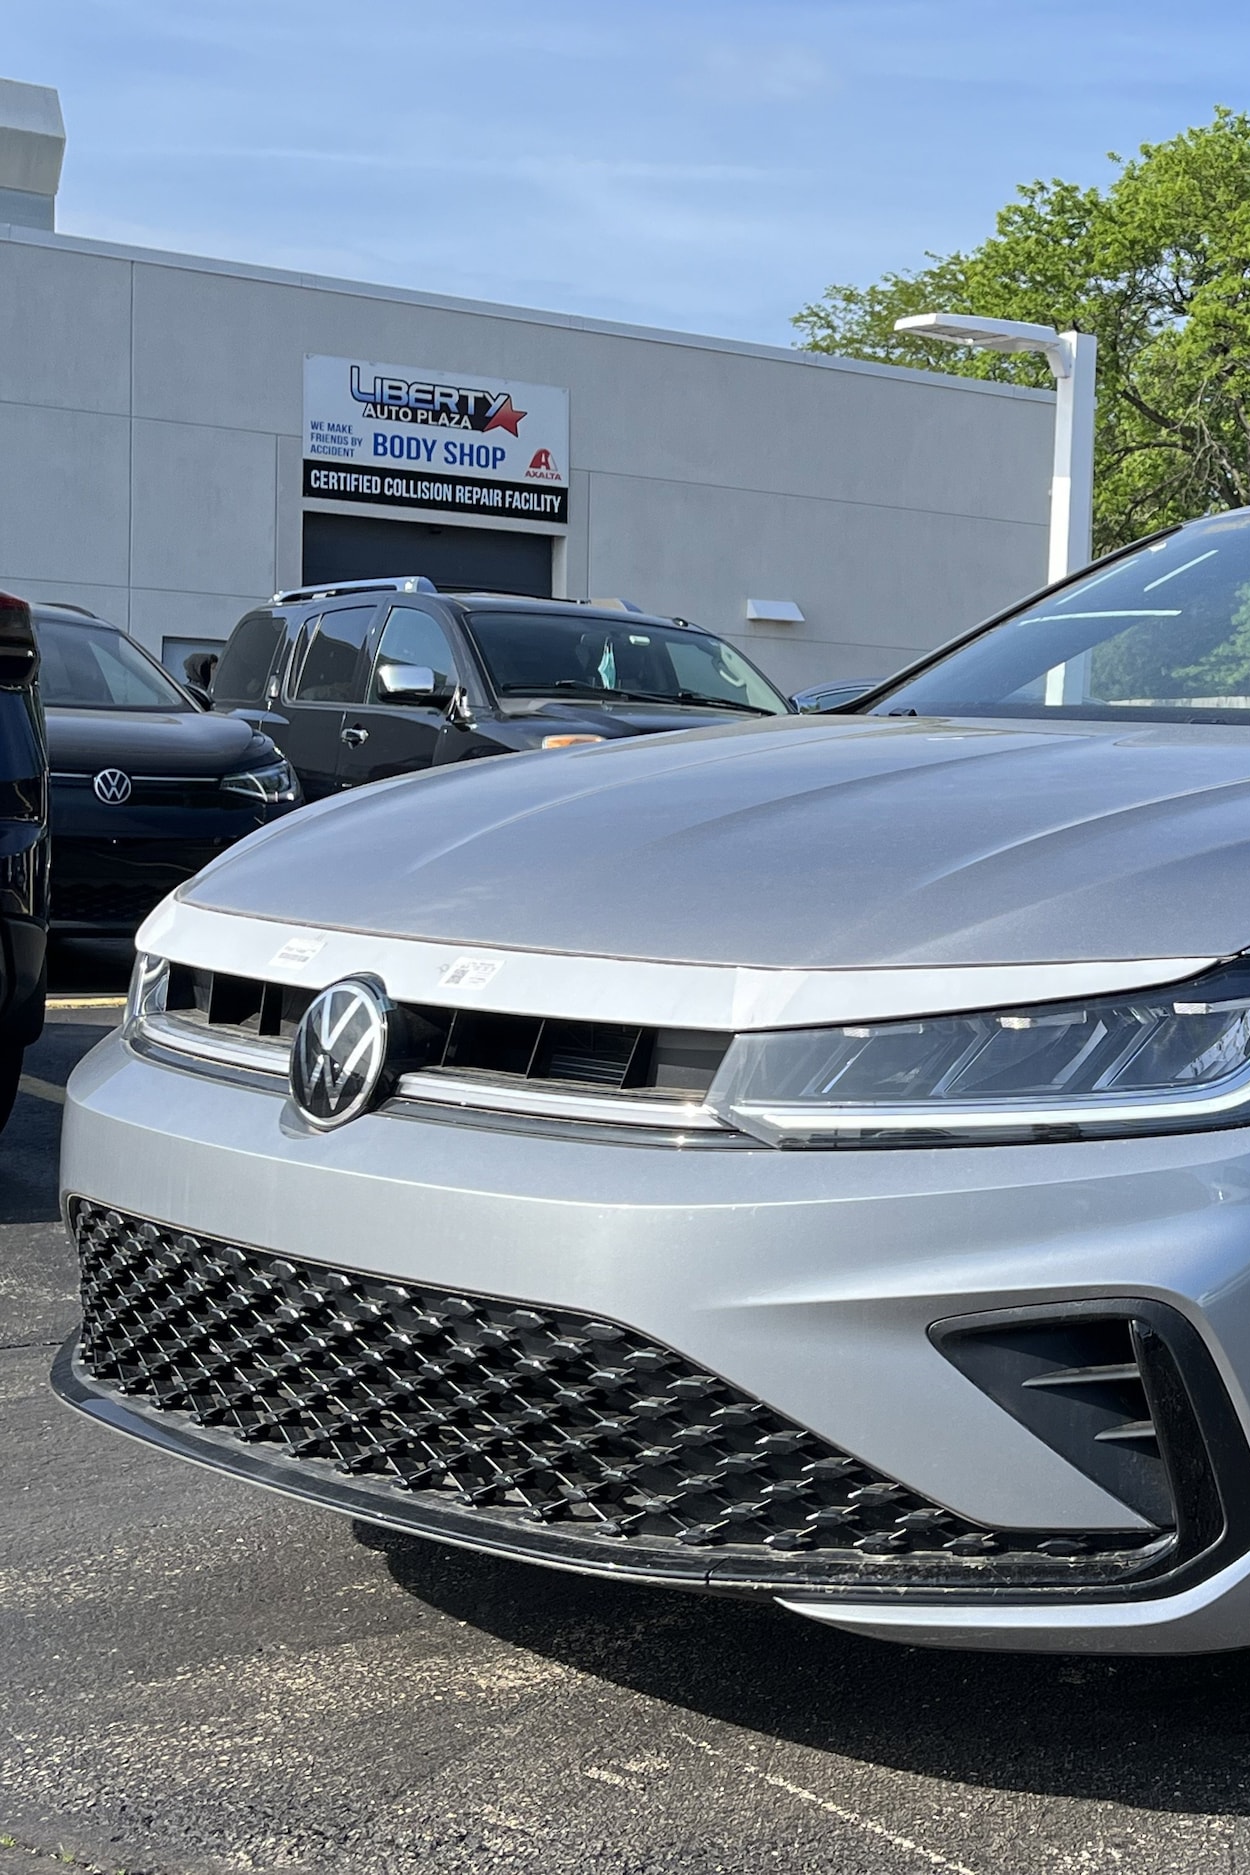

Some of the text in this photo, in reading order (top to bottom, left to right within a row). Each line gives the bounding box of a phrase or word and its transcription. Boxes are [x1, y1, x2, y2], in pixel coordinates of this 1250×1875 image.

[349, 365, 510, 417] LIBERTY
[363, 401, 472, 430] AUTO PLAZA
[310, 420, 353, 435] WE MAKE
[310, 432, 363, 447] FRIENDS BY
[310, 444, 355, 458] ACCIDENT
[373, 432, 506, 470] BODY SHOP
[524, 470, 562, 481] AXALTA
[310, 469, 562, 514] CERTIFIED COLLISION REPAIR FACILITY
